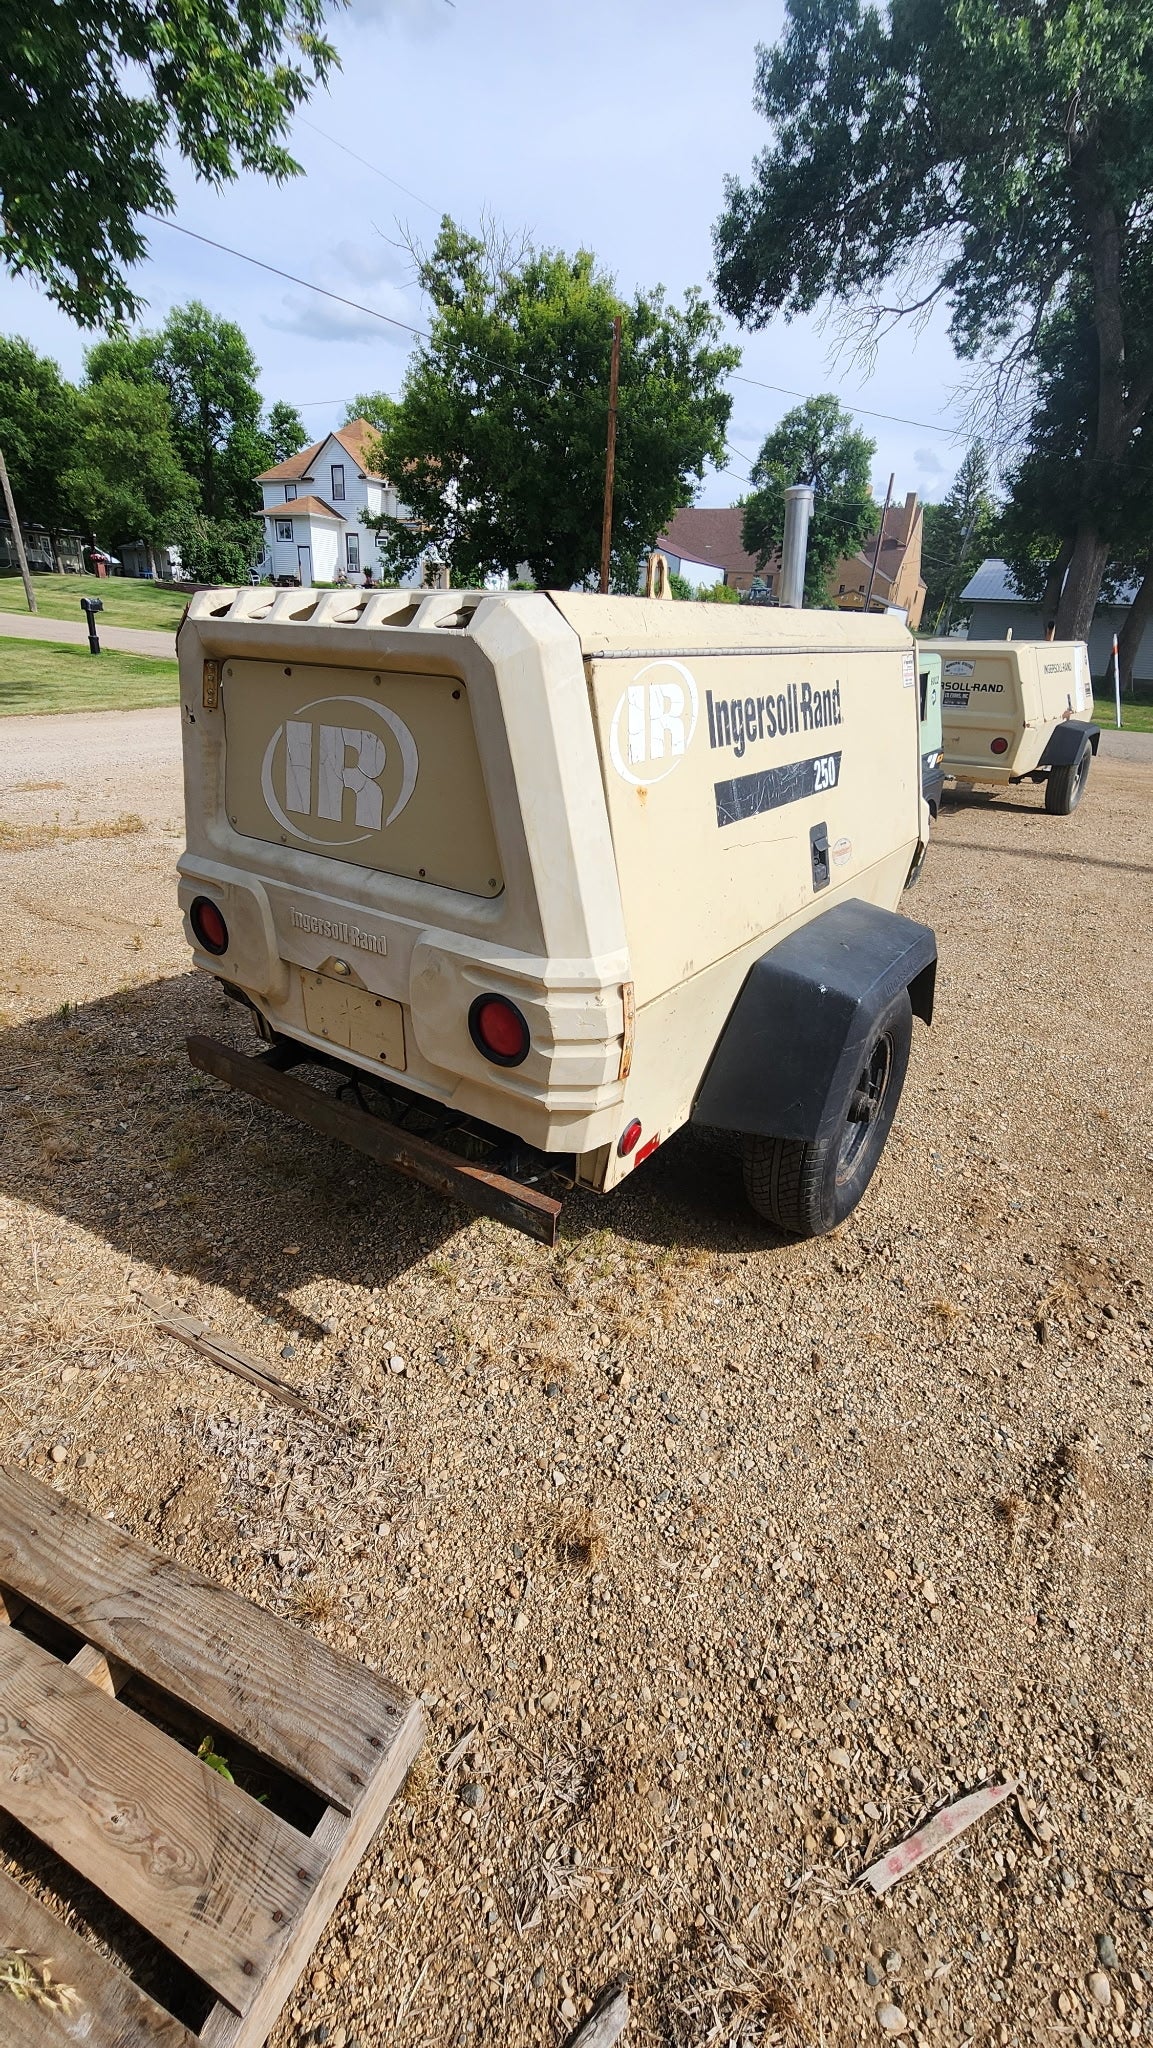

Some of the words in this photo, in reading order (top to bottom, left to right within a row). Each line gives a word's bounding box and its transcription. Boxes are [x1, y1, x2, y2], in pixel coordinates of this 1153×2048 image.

[627, 683, 685, 765] IR
[286, 720, 387, 831] IR
[813, 757, 836, 791] 250
